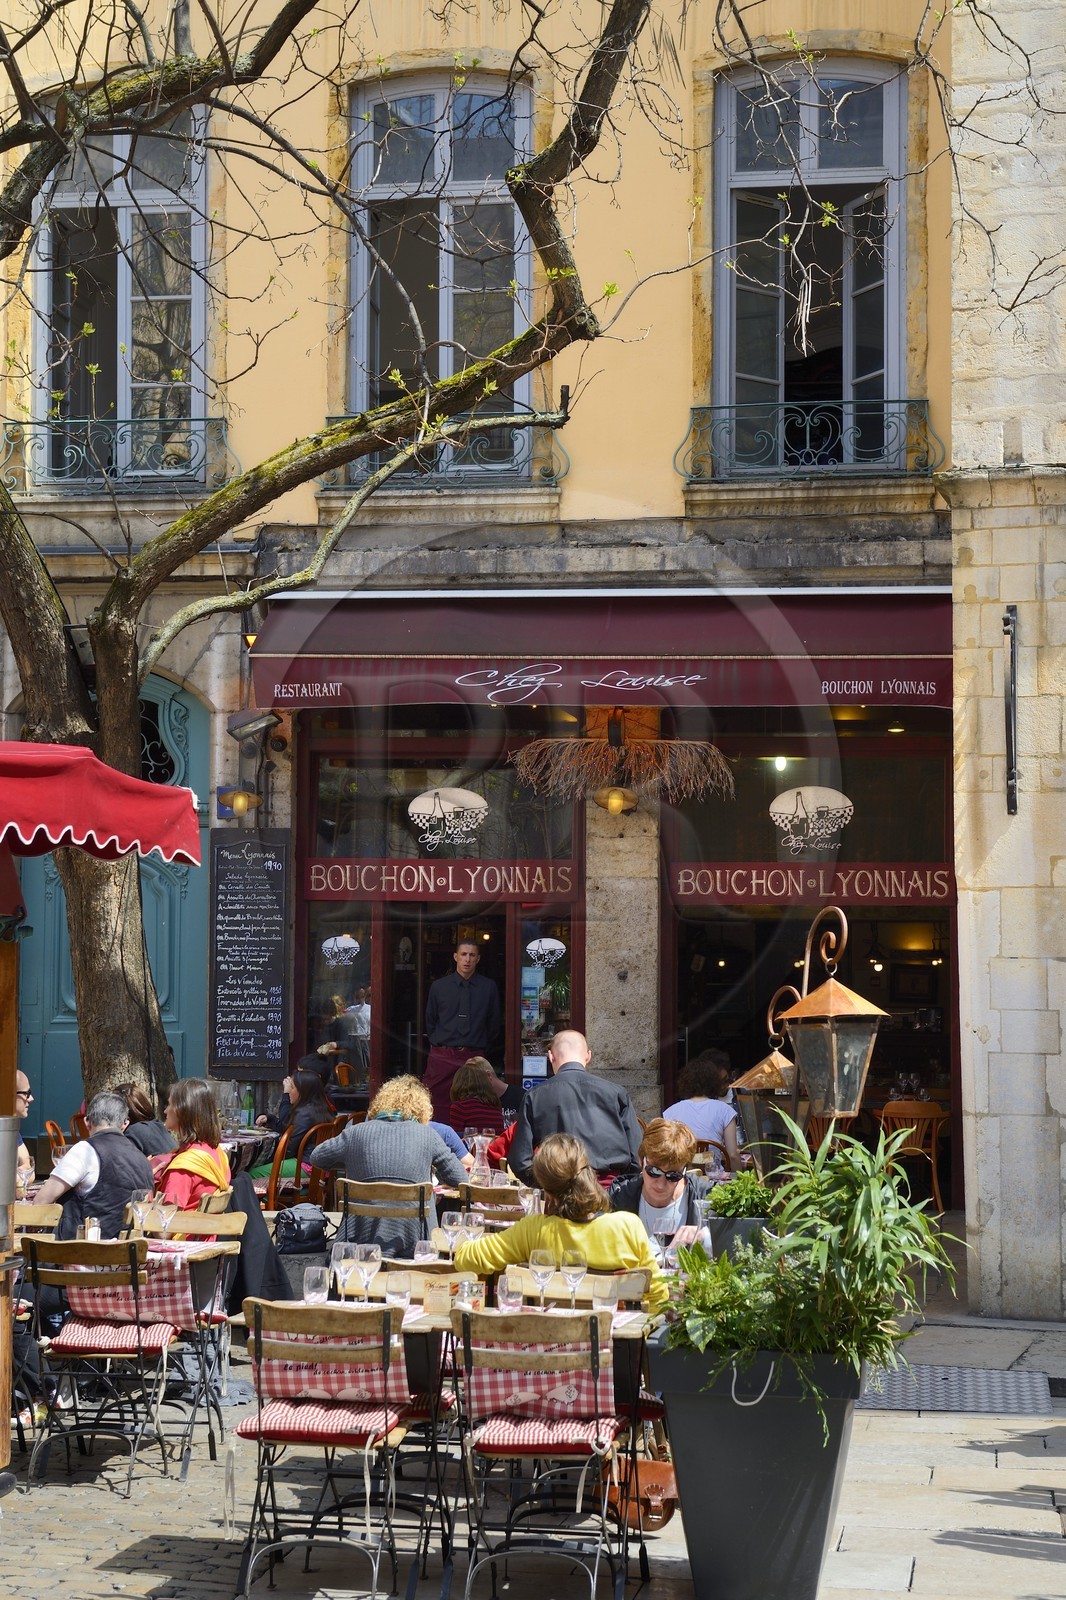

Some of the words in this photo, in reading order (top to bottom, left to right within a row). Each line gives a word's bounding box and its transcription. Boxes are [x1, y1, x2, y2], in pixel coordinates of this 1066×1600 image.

[273, 682, 343, 699] RESTAURANT
[454, 663, 563, 705] Chez
[580, 670, 708, 688] Louise
[821, 680, 873, 695] BOUCHON
[880, 678, 936, 696] LYONNAIS
[220, 849, 243, 860] Menu
[241, 842, 276, 866] Lyonnais
[310, 864, 436, 893] BOUCHON
[447, 865, 573, 894] LYONNAIS
[677, 868, 803, 897] BOUCHON
[818, 869, 949, 898] LYONNAIS
